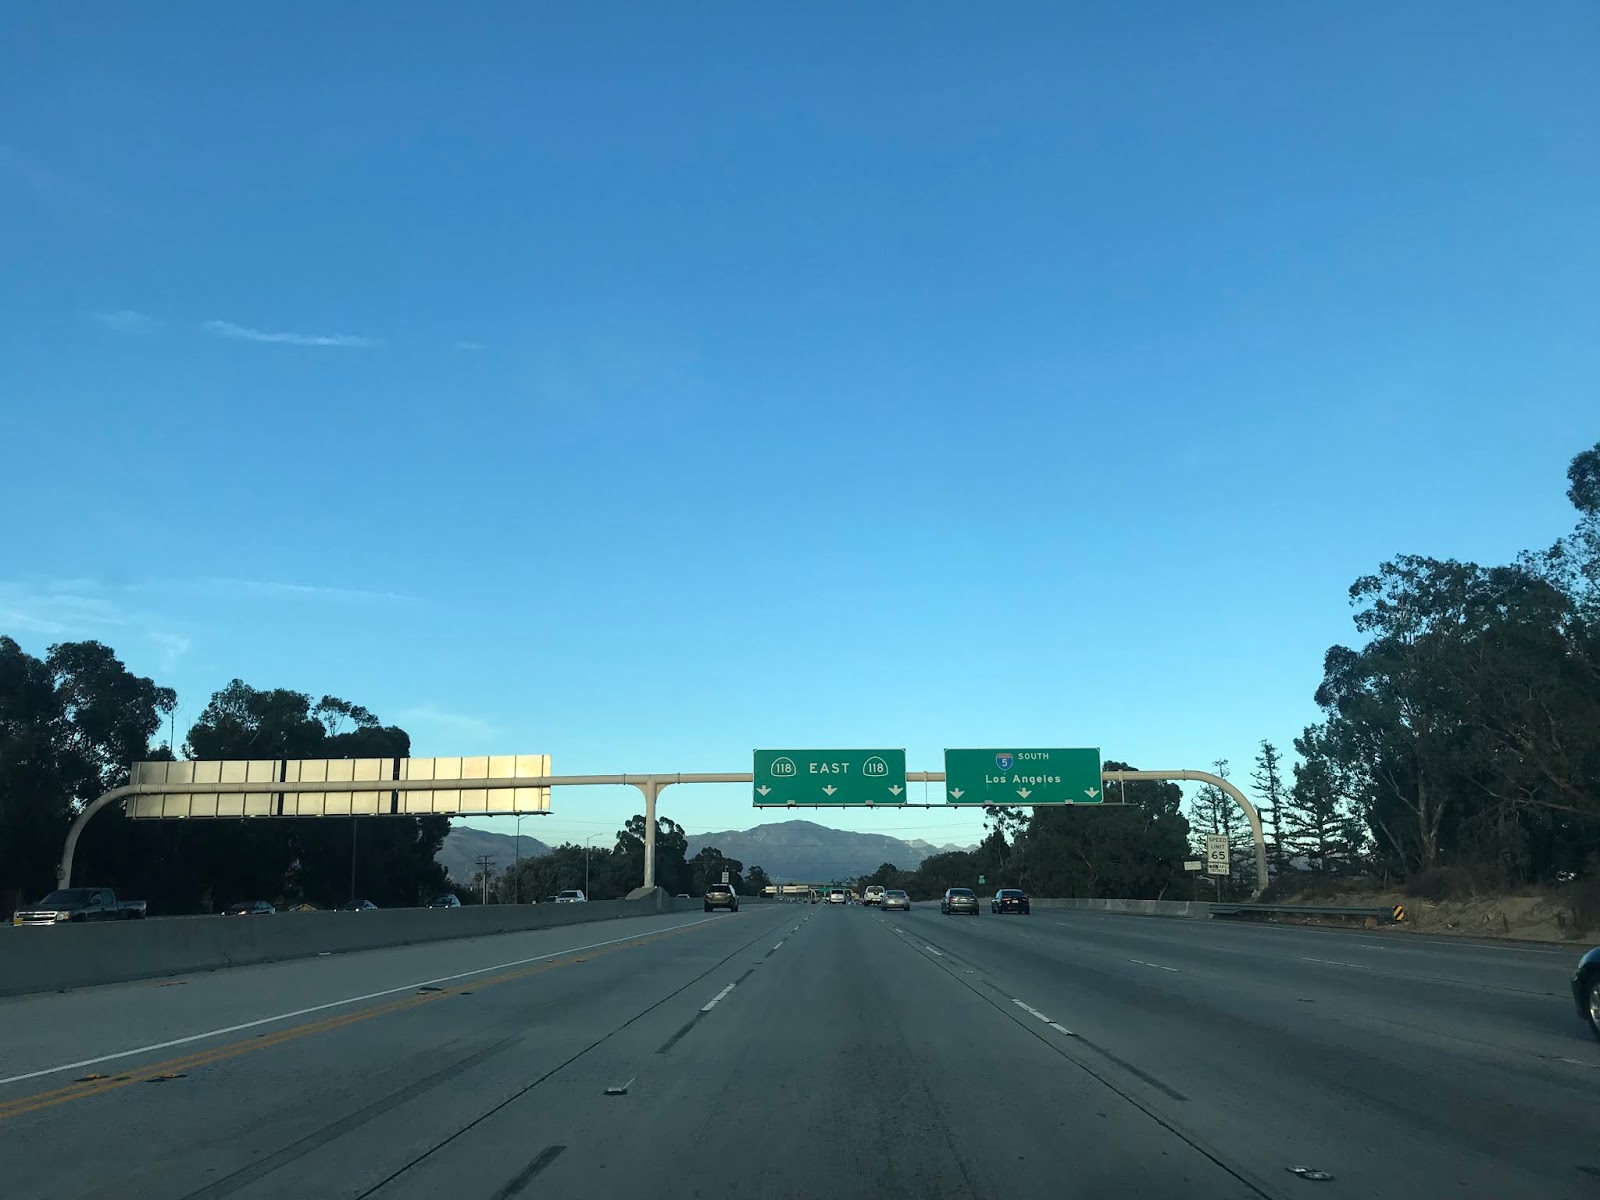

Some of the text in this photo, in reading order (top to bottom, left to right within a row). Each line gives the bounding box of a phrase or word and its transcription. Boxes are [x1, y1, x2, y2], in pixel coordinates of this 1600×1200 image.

[1002, 758, 1008, 766] 5
[776, 763, 884, 774] 118 EAST 118
[985, 775, 1061, 786] Los Angeles
[1212, 851, 1226, 860] 65
